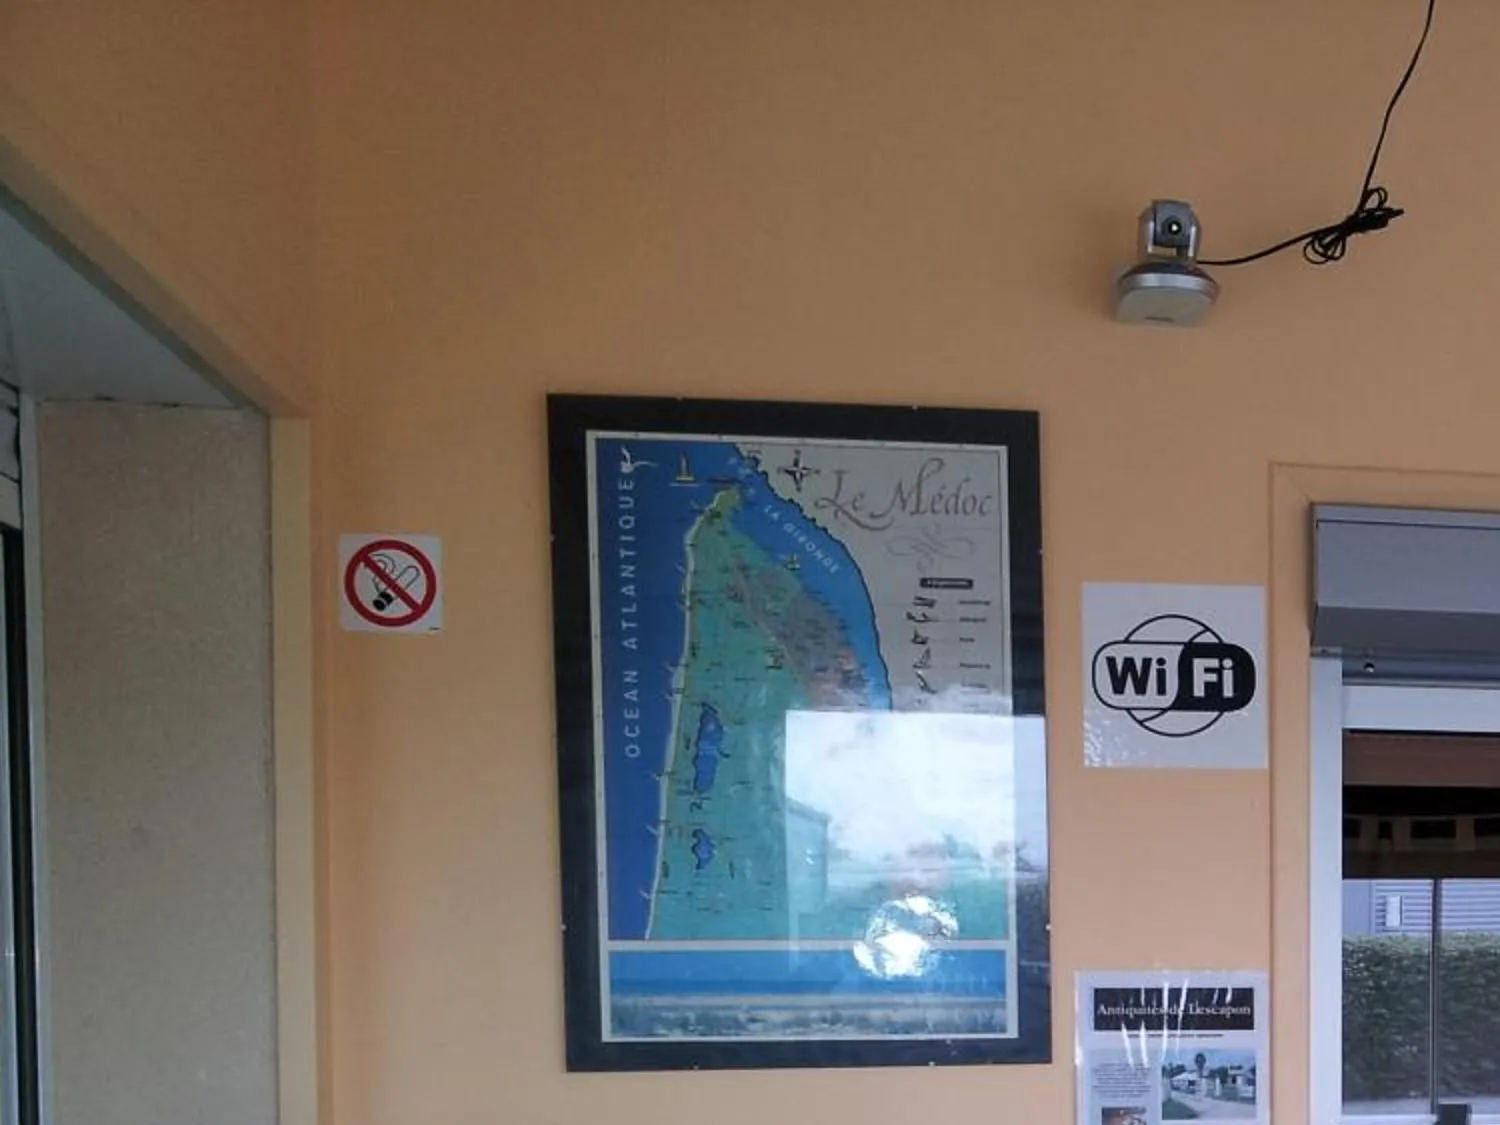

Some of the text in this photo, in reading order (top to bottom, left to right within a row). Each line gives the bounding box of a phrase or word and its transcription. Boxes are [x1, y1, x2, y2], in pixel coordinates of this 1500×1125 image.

[618, 477, 641, 758] OCEAN ATLANTIQUE
[1105, 655, 1235, 699] Wi Fi
